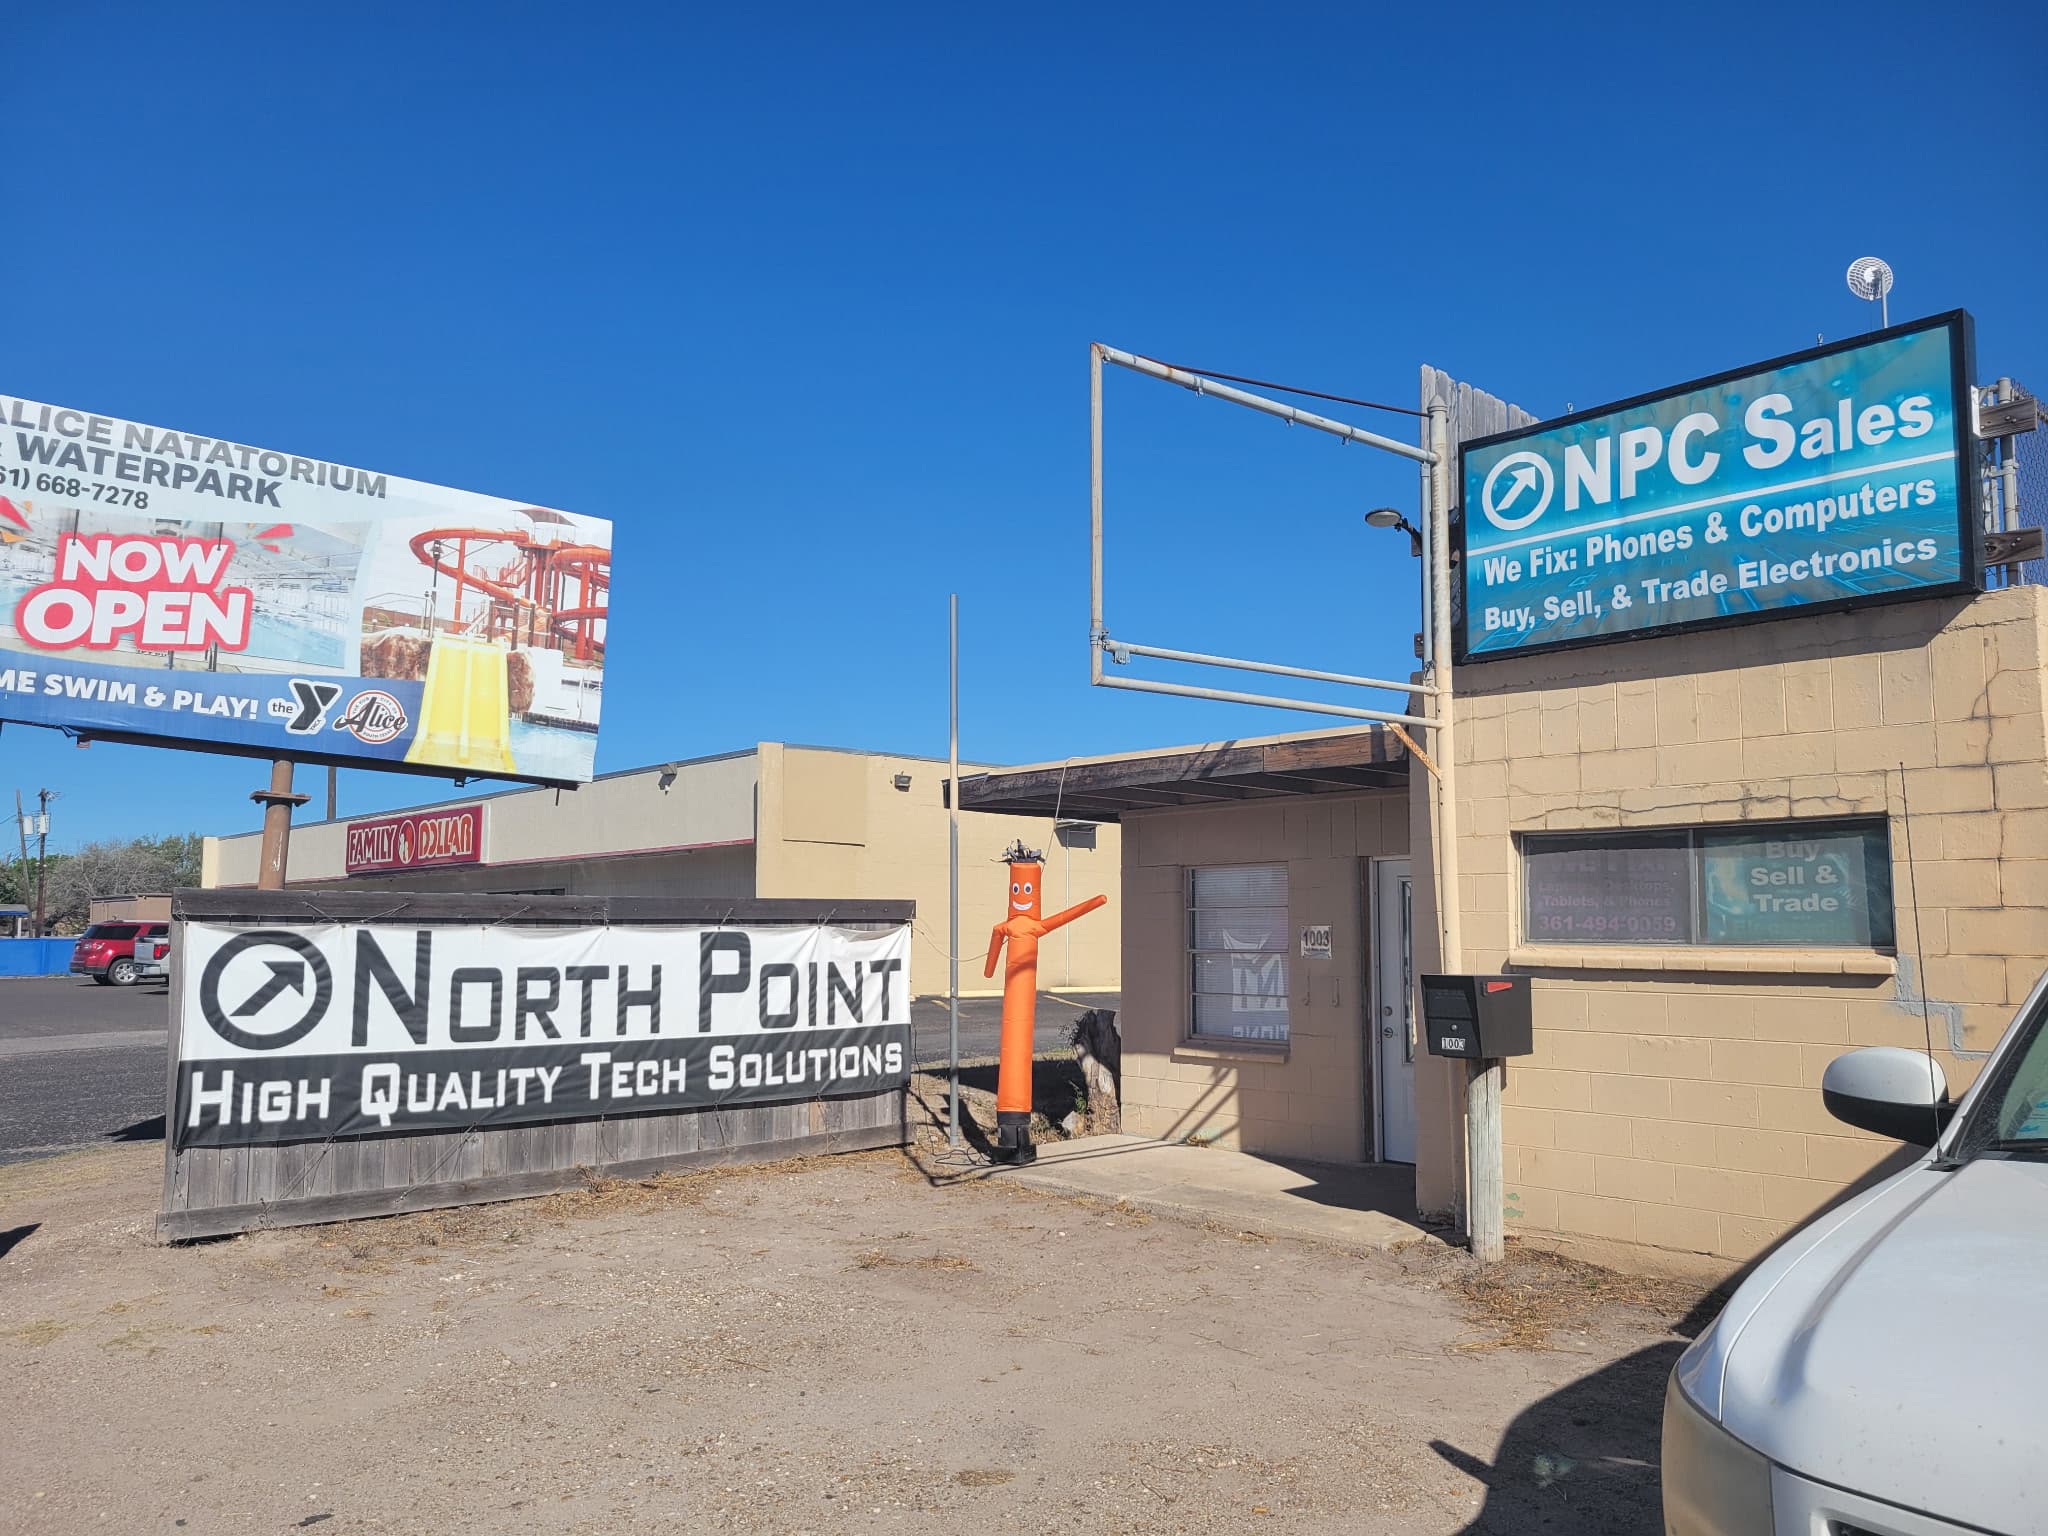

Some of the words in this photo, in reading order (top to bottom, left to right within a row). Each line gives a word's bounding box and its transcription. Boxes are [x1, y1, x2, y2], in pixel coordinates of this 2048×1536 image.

[0, 400, 112, 445] LICE
[123, 423, 387, 499] NATATORIUM
[16, 432, 283, 508] WATERPARK
[1564, 412, 1720, 512] NPC
[1742, 393, 1934, 471] Sales
[36, 473, 149, 509] 668-7278
[1484, 555, 1521, 586] We
[1530, 546, 1577, 577] Fix:
[1586, 526, 1693, 567] Phones
[1704, 511, 1729, 544] &
[1740, 479, 1937, 537] Computers
[62, 538, 229, 584] NOW
[1485, 605, 1536, 631] Buy,
[1543, 590, 1600, 619] Sell,
[1611, 584, 1632, 610] &
[1641, 569, 1728, 604] Trade
[1739, 538, 1938, 590] Electronics
[23, 588, 247, 645] OPEN
[44, 673, 136, 704] SWIM
[144, 686, 166, 707] &
[173, 690, 258, 720] PLAY!
[272, 702, 293, 714] the
[334, 697, 407, 732] Alice
[348, 824, 397, 865] FAMILY
[418, 813, 473, 859] DOLLAR
[1765, 841, 1820, 862] Buy
[1751, 866, 1805, 886] Sell
[1815, 865, 1839, 884] &
[1752, 893, 1839, 913] Trade
[1303, 930, 1330, 946] 1003
[351, 929, 662, 1046] NORTH
[698, 931, 902, 1033] POINT
[1442, 1038, 1465, 1050] 1003
[188, 1070, 331, 1127] HIGH
[361, 1063, 563, 1126] QUALITY
[581, 1052, 686, 1100] TECH
[708, 1043, 902, 1090] SOLUTIONS
